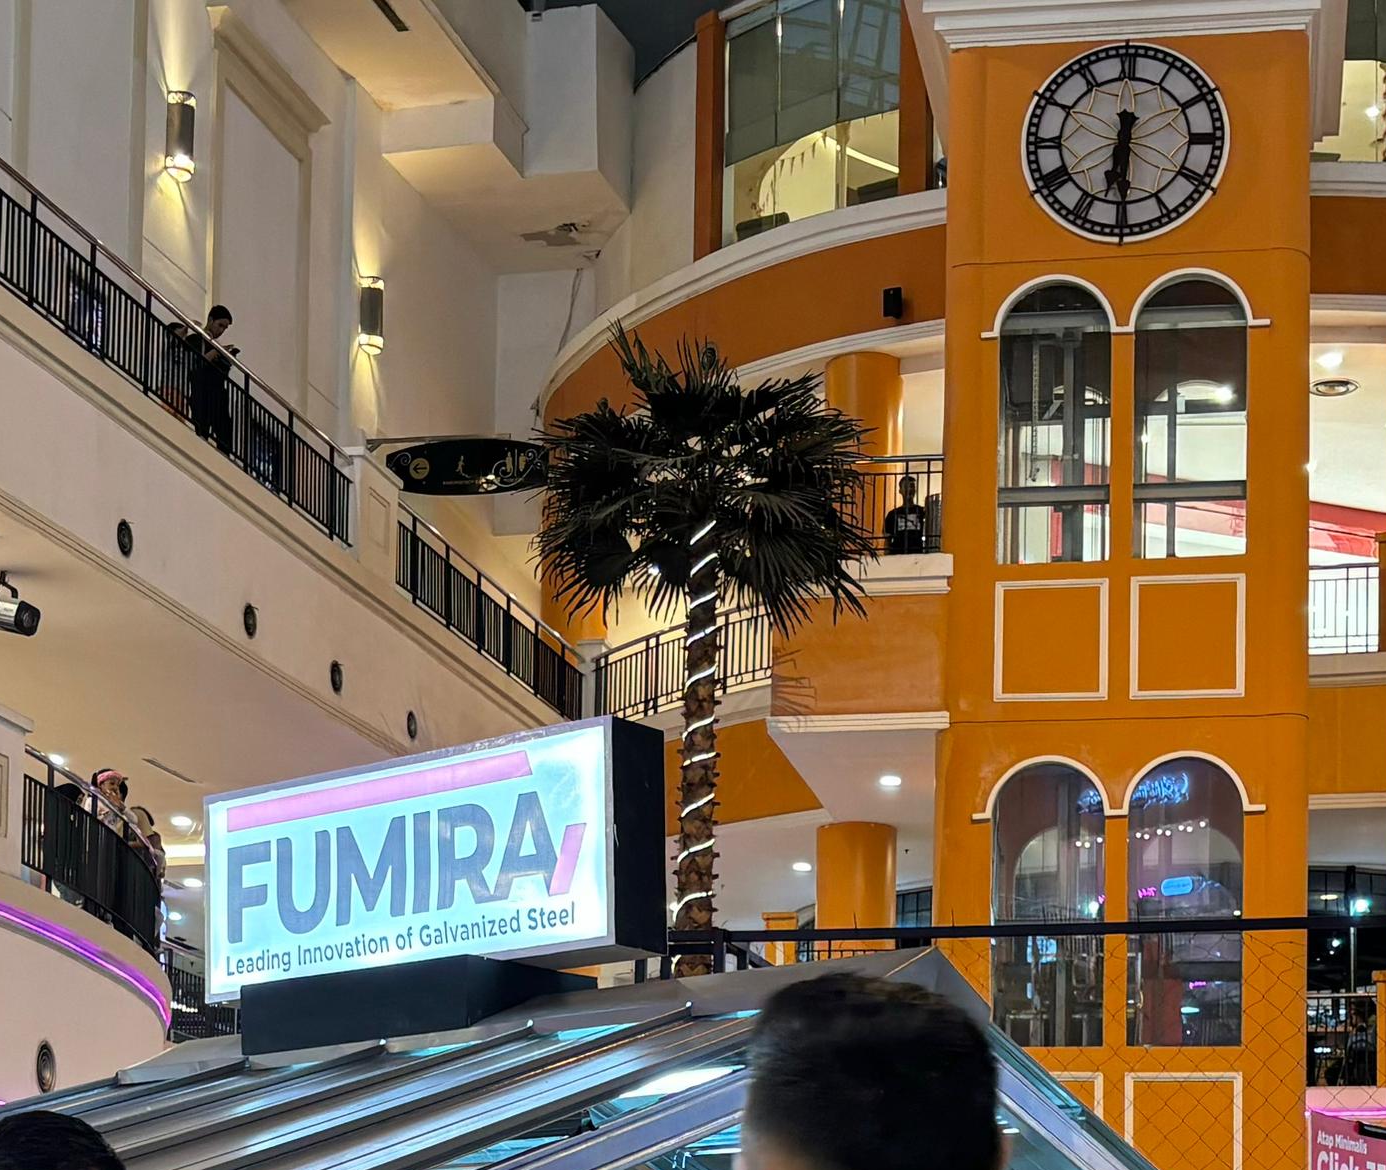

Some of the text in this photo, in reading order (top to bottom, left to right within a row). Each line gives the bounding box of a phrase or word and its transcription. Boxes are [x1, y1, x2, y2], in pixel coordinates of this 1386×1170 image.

[227, 791, 559, 943] FUMIRA
[226, 902, 575, 976] Leading Innovation of Galvanized Steel
[1317, 1130, 1368, 1155] Atap Minimalis
